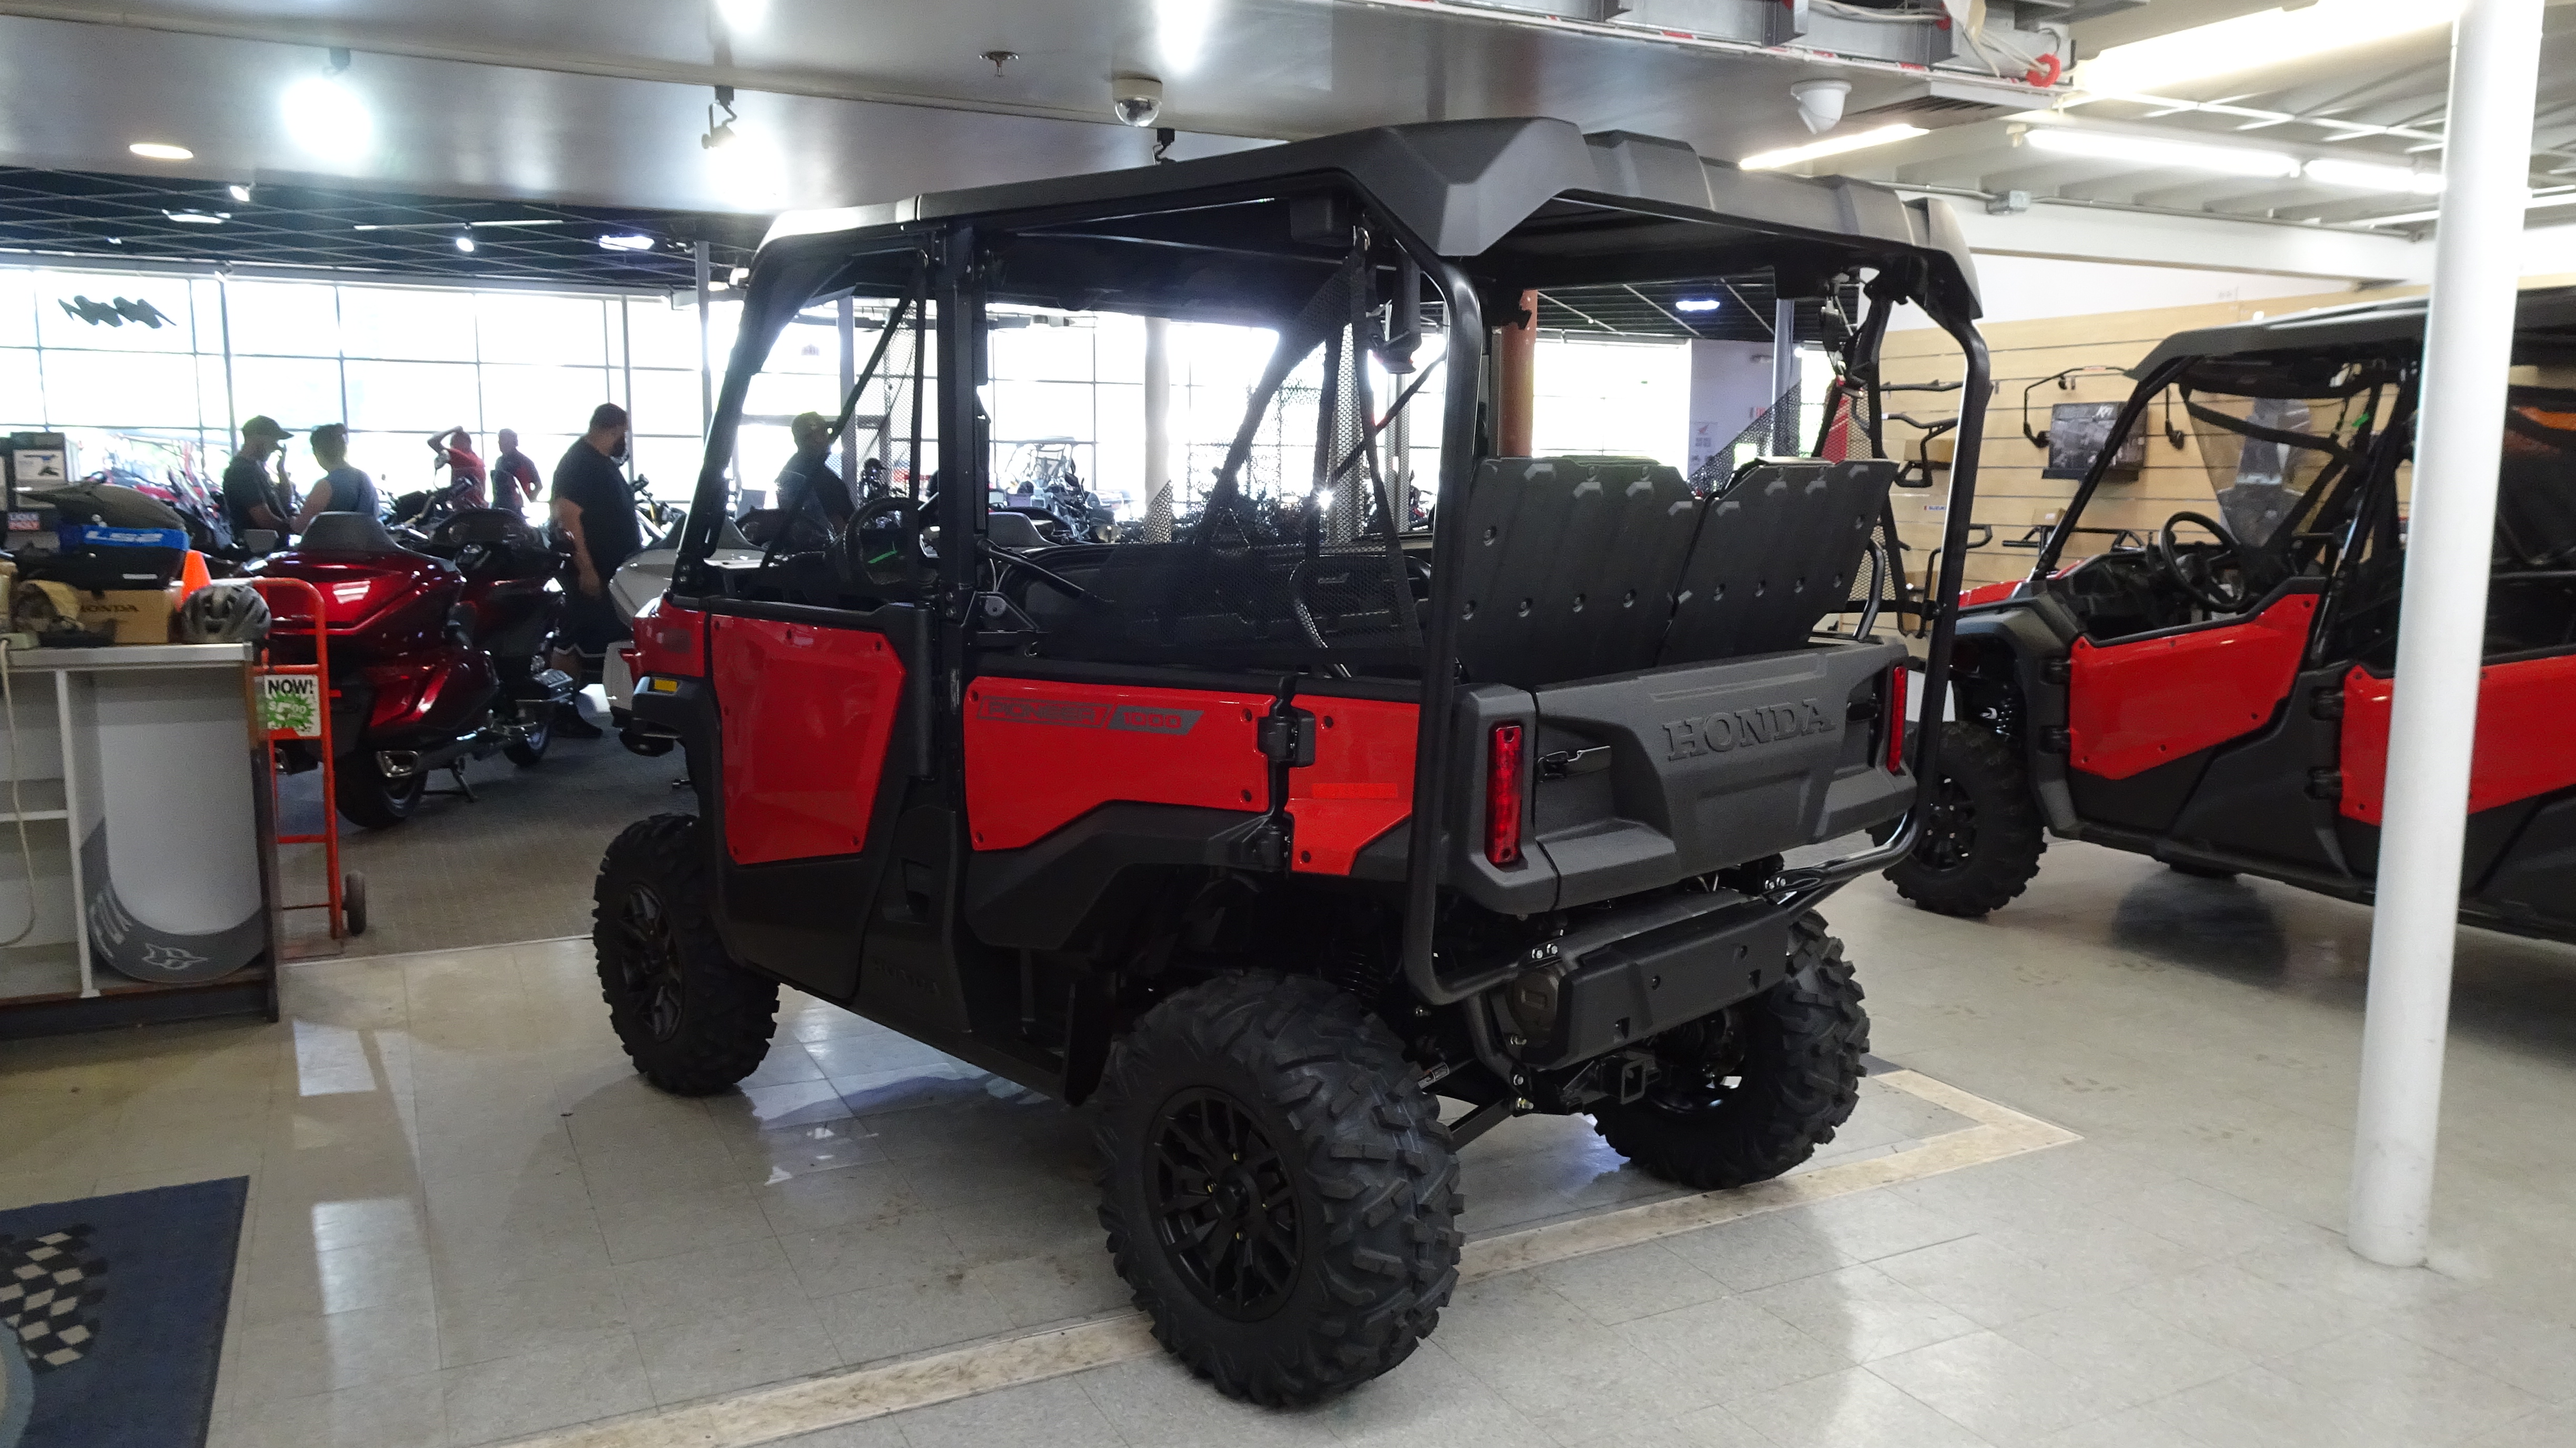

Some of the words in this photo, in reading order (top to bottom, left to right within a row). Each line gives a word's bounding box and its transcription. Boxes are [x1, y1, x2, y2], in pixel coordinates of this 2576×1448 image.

[267, 679, 314, 695] NOW!
[988, 701, 1095, 723] PIONEER
[1123, 711, 1182, 729] 1000
[1661, 698, 1836, 762] HONDA
